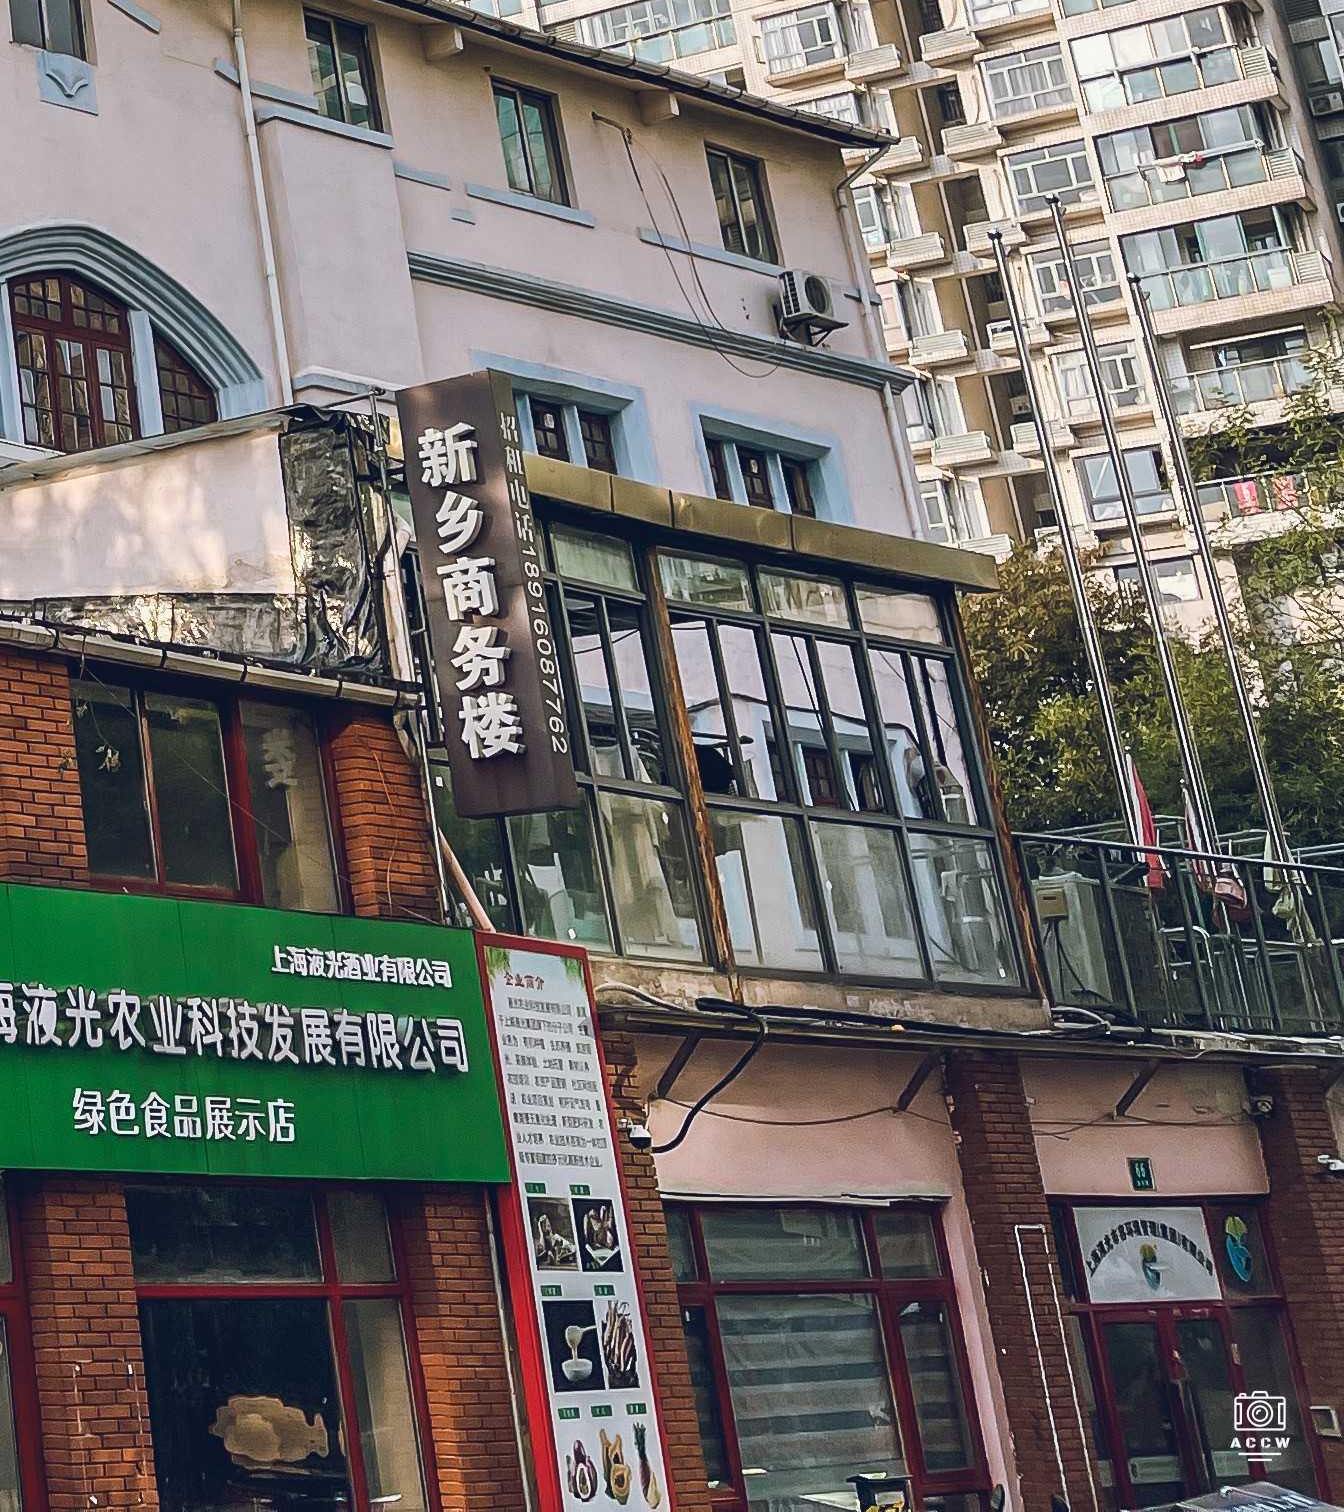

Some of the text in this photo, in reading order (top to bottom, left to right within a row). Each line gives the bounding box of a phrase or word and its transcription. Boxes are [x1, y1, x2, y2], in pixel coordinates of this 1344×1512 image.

[417, 421, 526, 759] 新乡商务楼
[271, 944, 453, 989] 上海液光酒业有限公司
[72, 1088, 296, 1143] 绿色食品展示店
